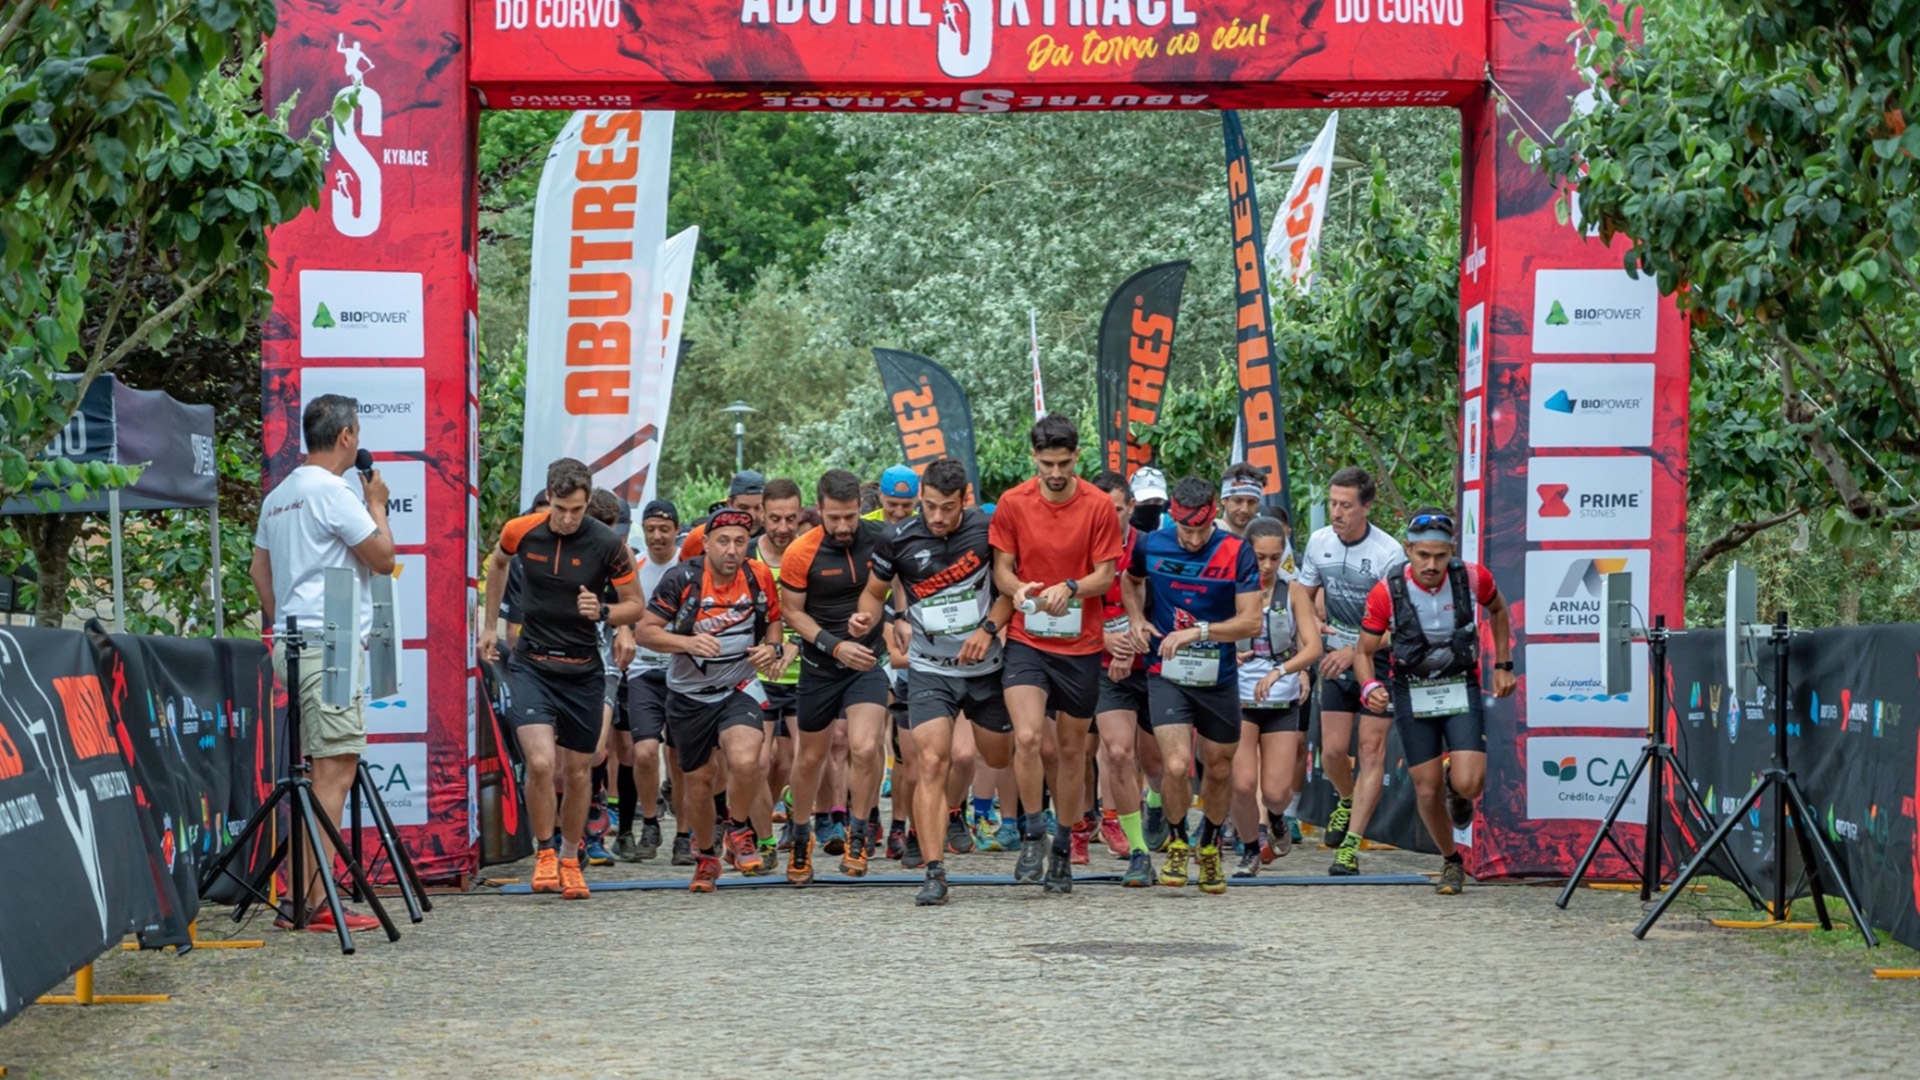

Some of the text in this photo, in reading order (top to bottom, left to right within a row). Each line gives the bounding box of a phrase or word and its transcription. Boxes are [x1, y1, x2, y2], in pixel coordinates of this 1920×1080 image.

[495, 0, 620, 29] DO CORVO
[1335, 0, 1464, 26] DO CORVO
[1027, 34, 1074, 72] Da
[1082, 30, 1157, 66] terra
[1167, 31, 1200, 56] ao
[1211, 14, 1270, 50] céu!
[564, 109, 643, 416] ABUTRES
[340, 311, 407, 323] BIOPOWER
[1574, 308, 1641, 320] BIOPOWER
[1581, 399, 1640, 409] BIOPOWER
[1580, 494, 1639, 507] PRIME
[1579, 509, 1616, 518] STONES
[1549, 601, 1600, 612] ARNAU
[1544, 614, 1600, 625] & FILHO
[1586, 757, 1630, 787] CA
[1558, 792, 1595, 802] Crédito
[383, 799, 412, 808] rícola
